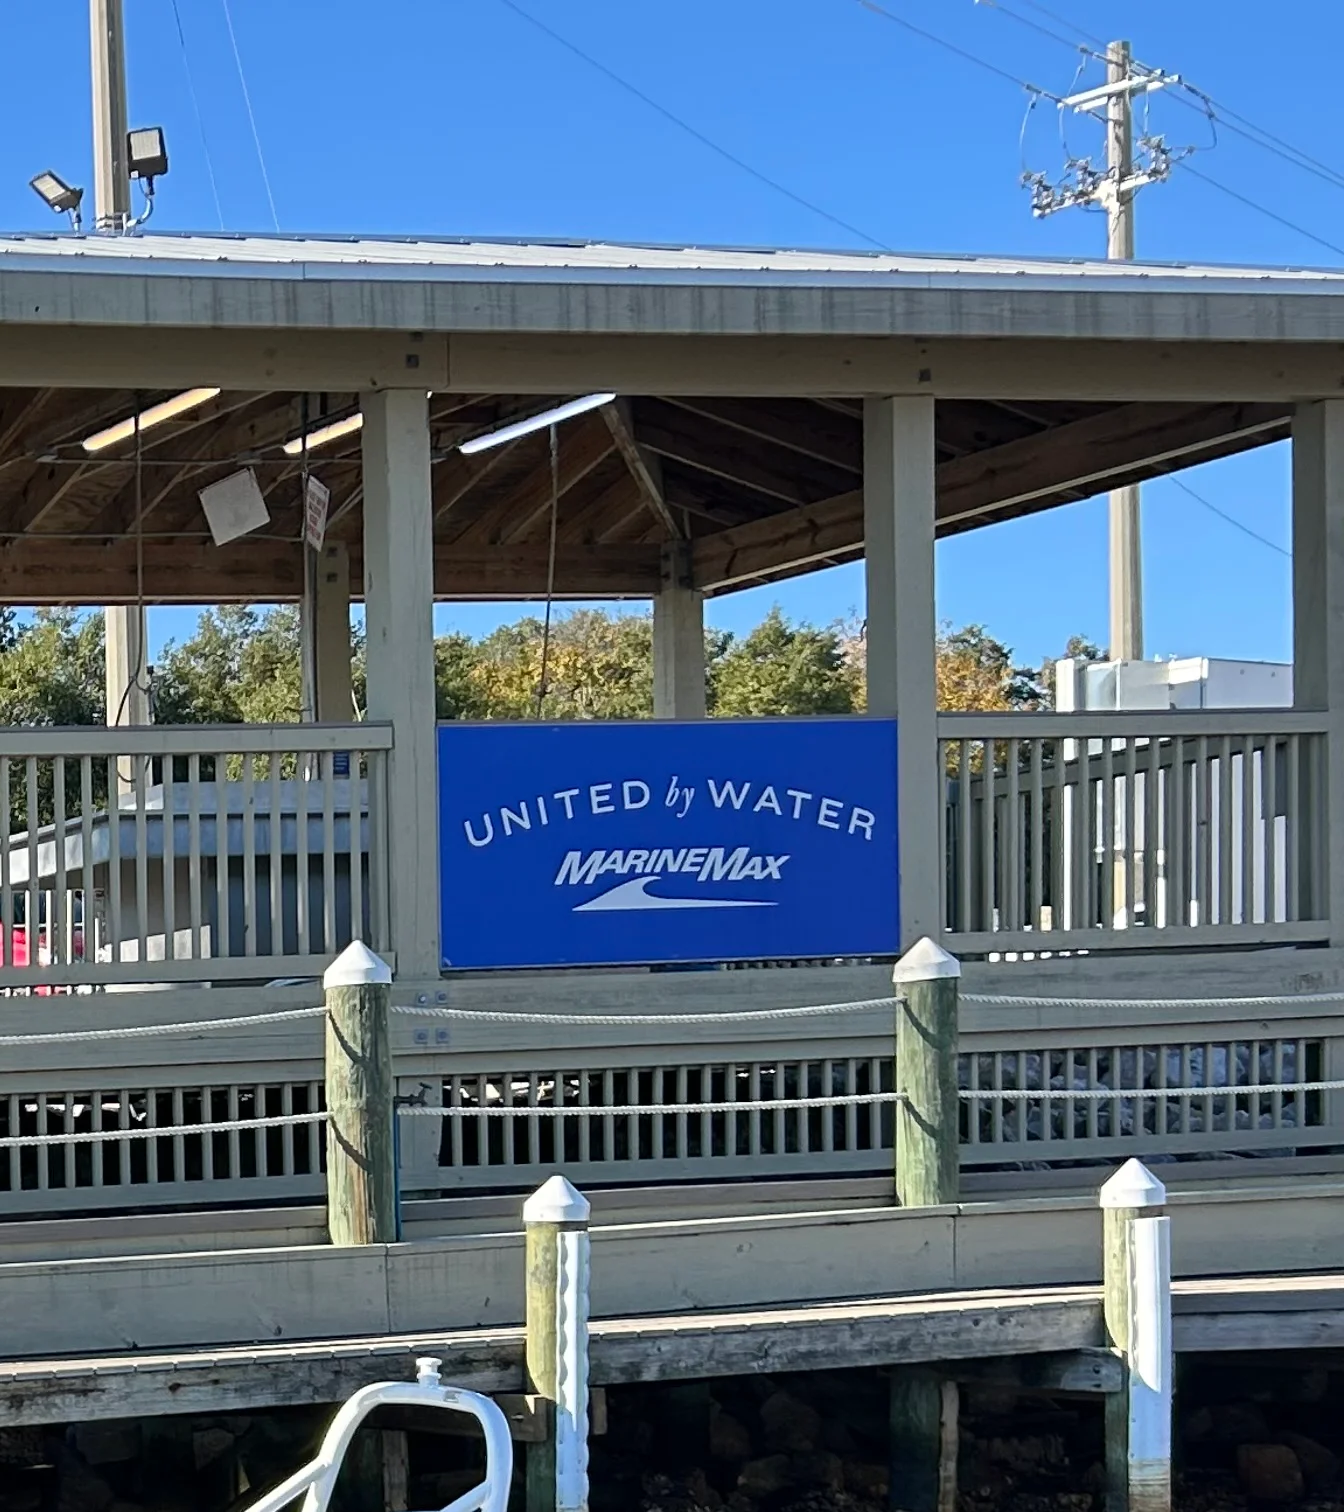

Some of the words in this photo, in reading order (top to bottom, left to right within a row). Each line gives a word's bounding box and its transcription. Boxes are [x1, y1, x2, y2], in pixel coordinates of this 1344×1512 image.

[463, 779, 651, 848] UNITED
[664, 775, 695, 818] by
[707, 779, 876, 841] WATER
